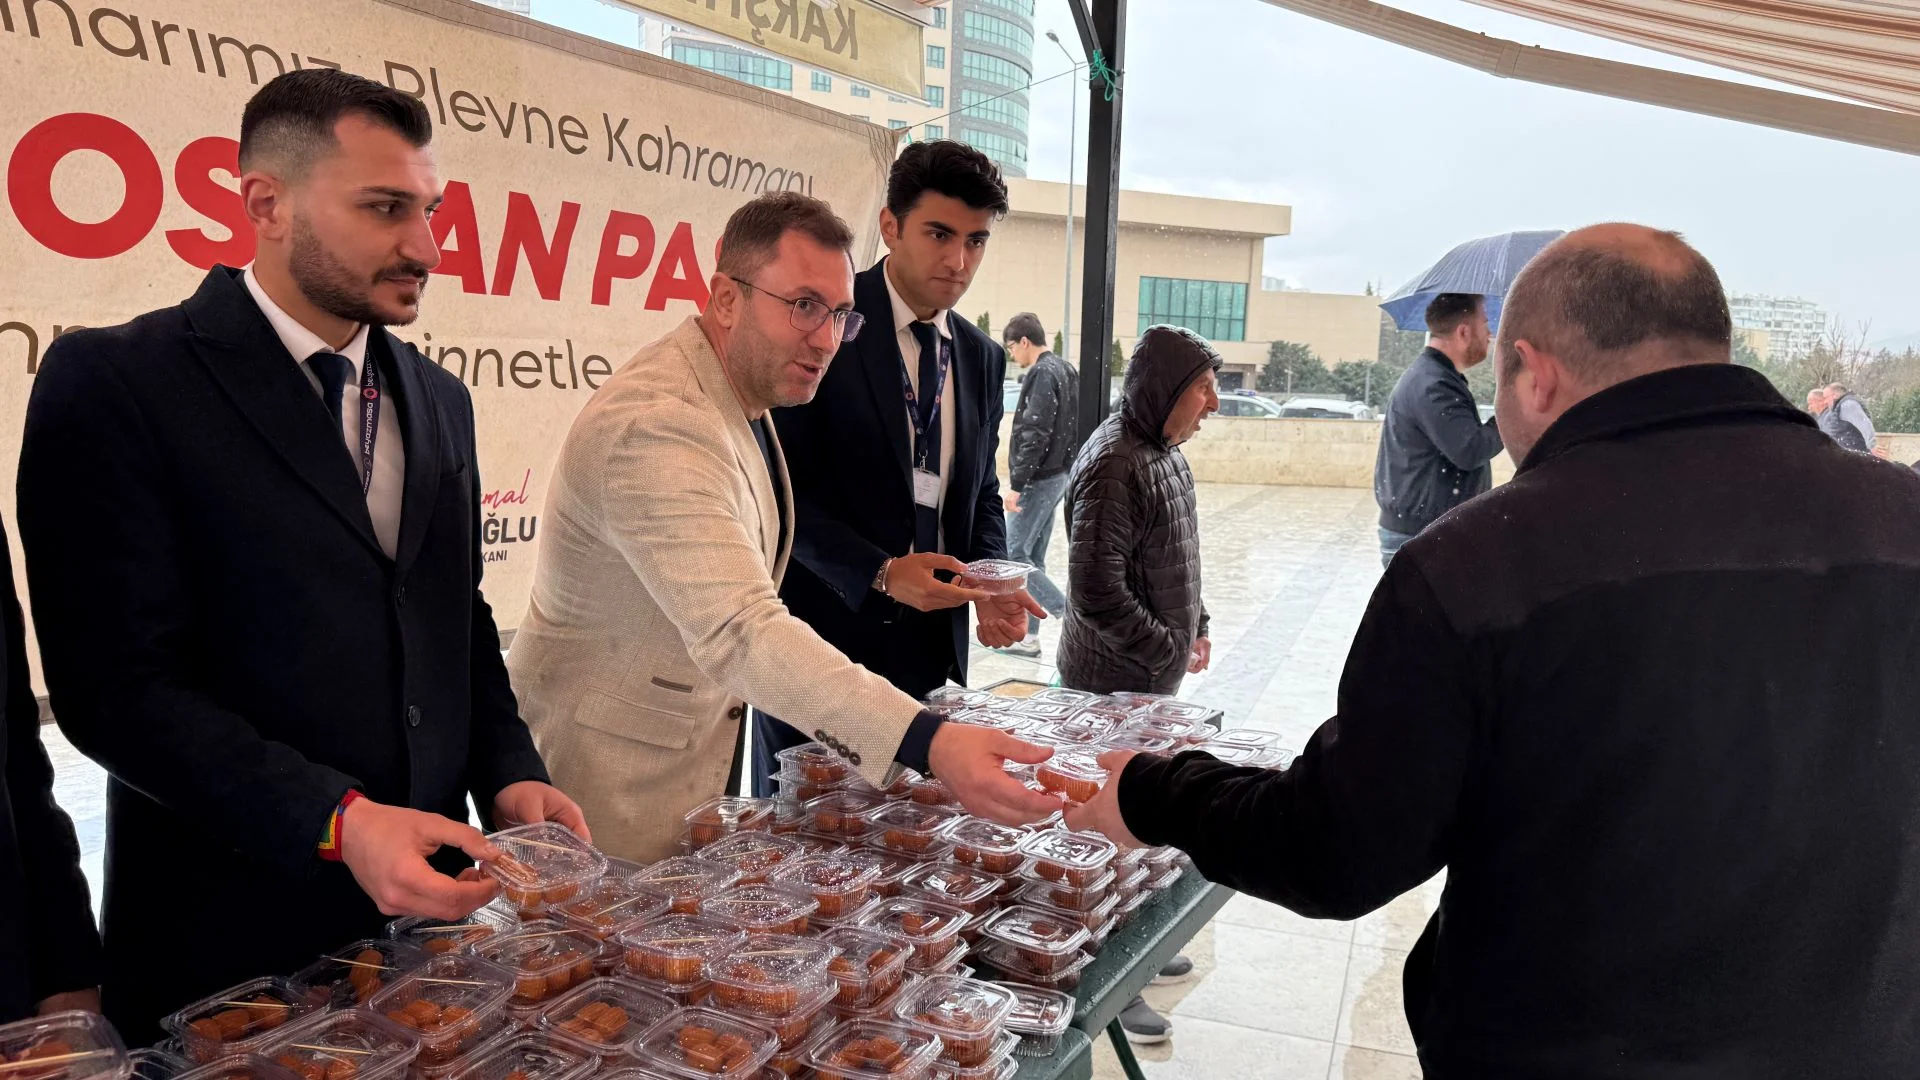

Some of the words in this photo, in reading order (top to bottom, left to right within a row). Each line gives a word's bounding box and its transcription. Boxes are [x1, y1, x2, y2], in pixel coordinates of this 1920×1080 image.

[384, 60, 589, 156] Plevne
[602, 112, 813, 198] Kahramanı
[7, 112, 581, 301] OSAN
[591, 210, 725, 316] PA
[364, 402, 374, 455] beyazmasa
